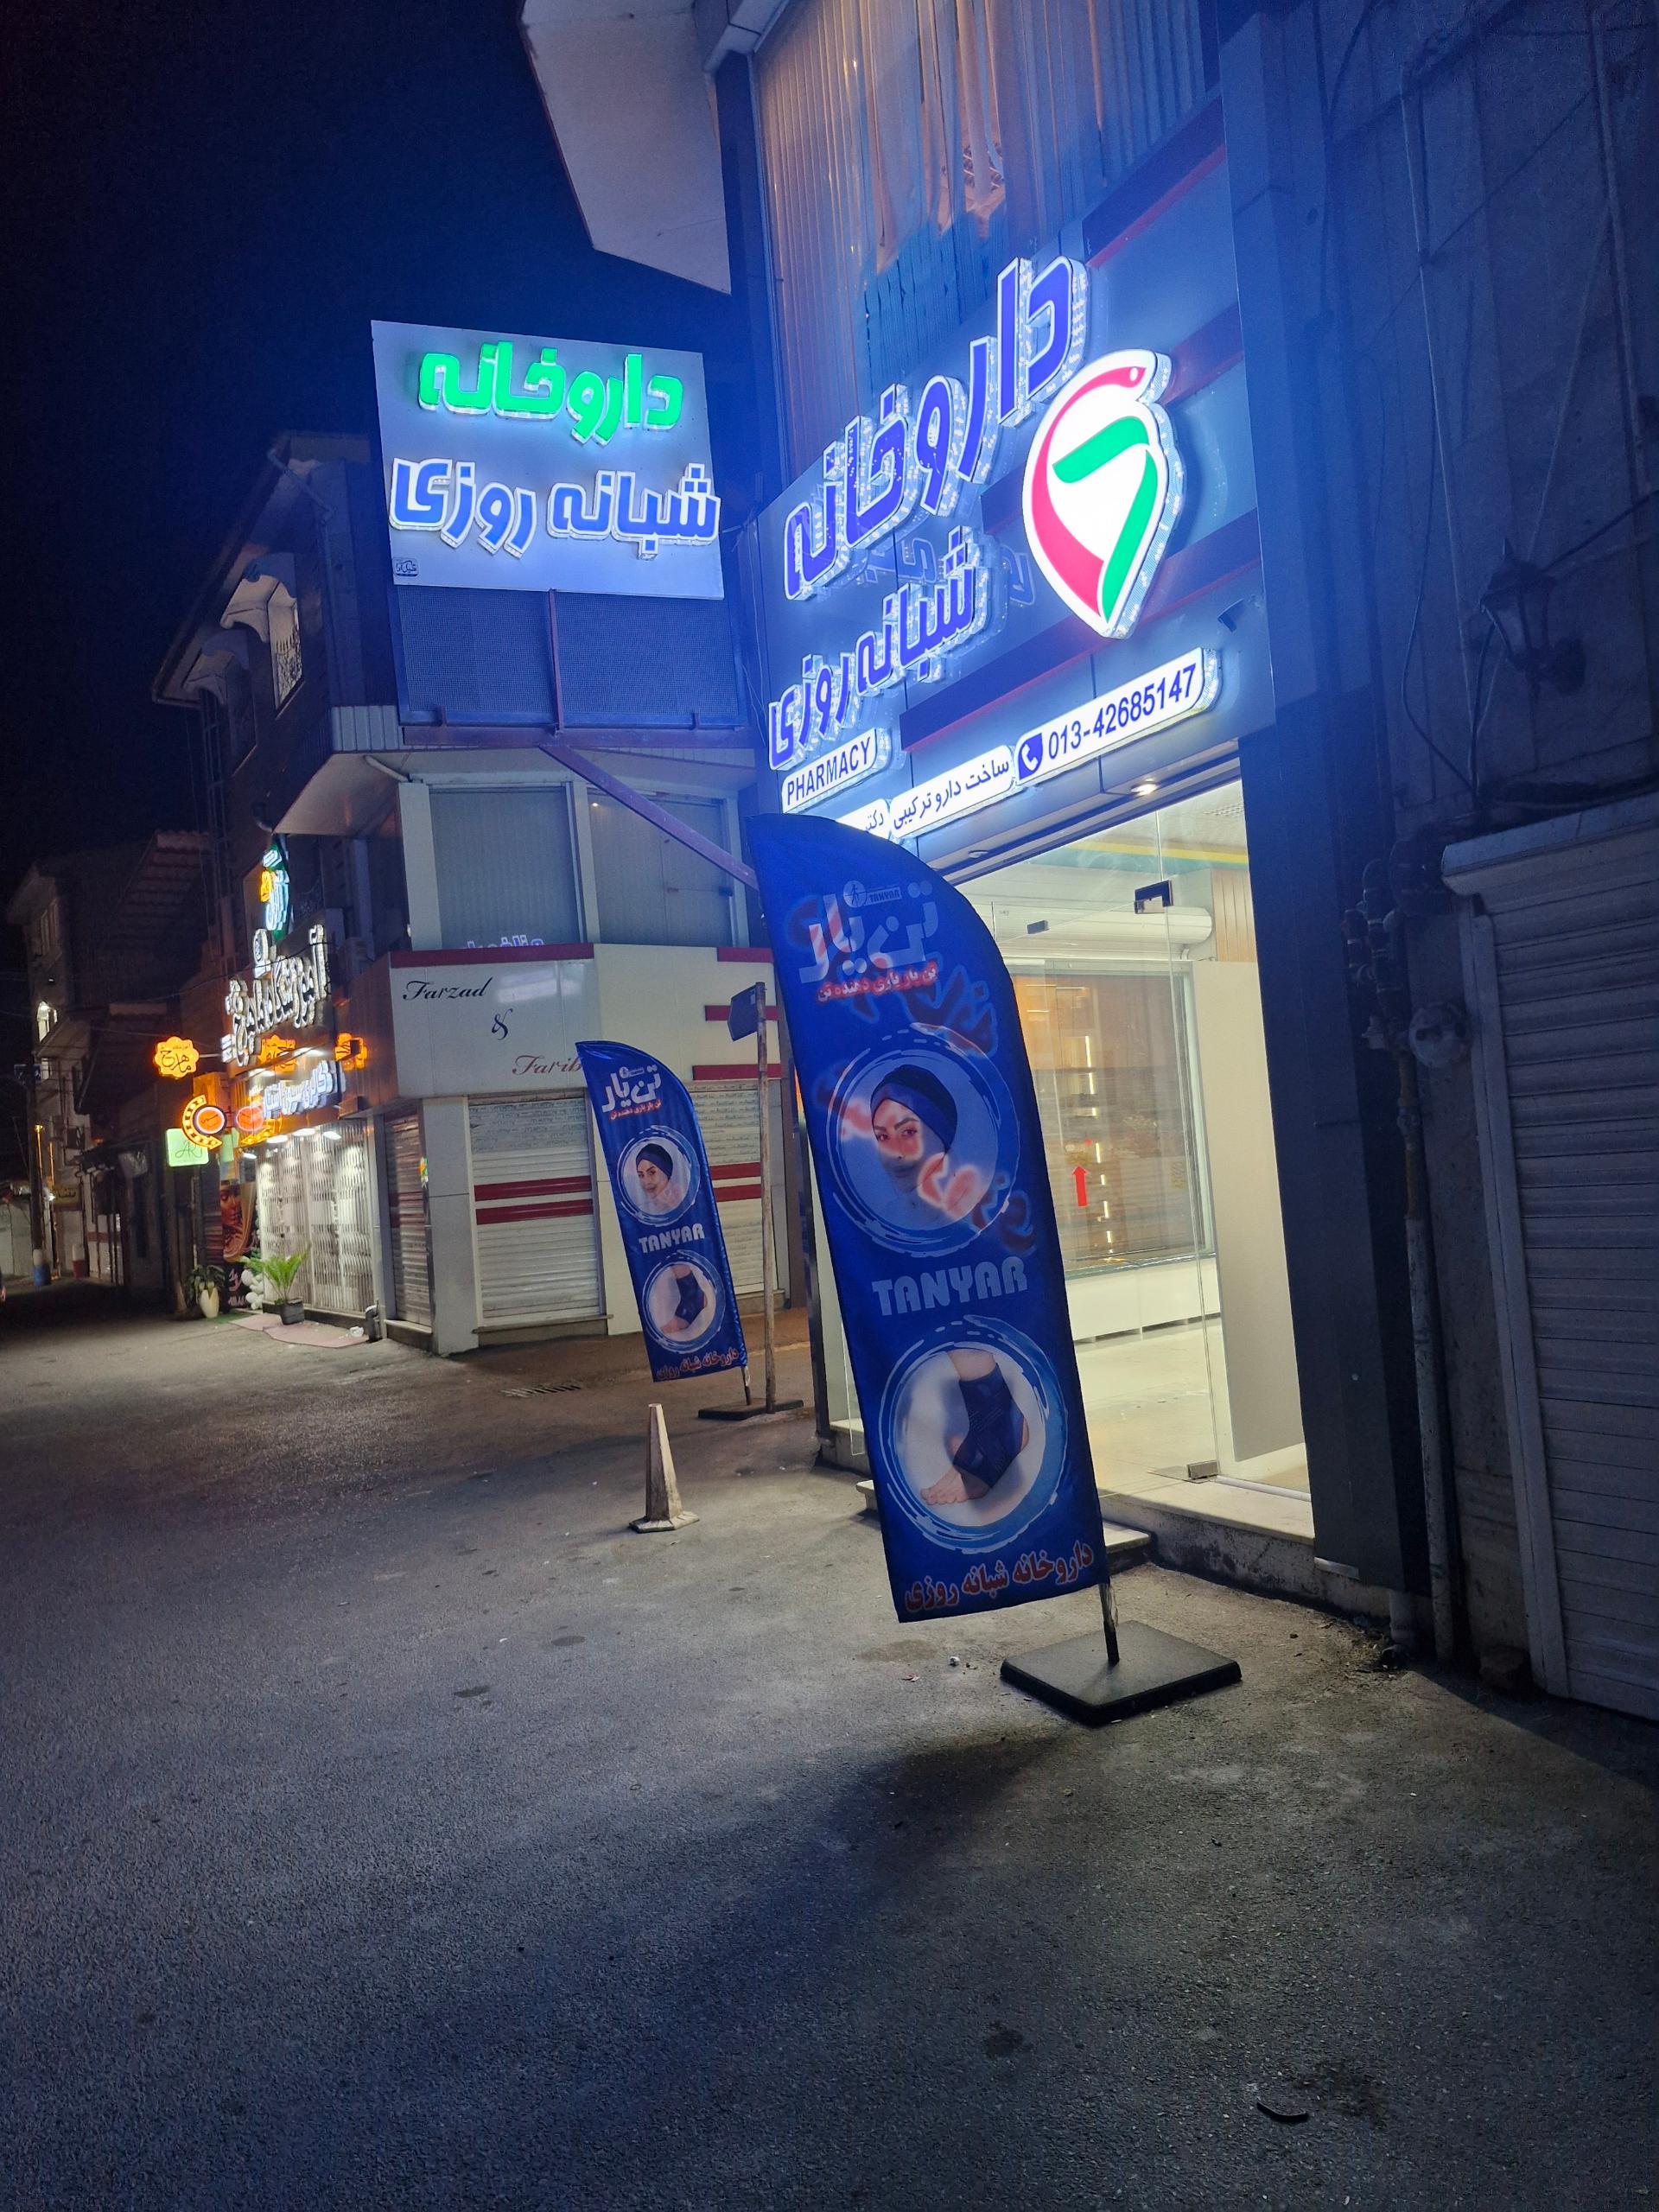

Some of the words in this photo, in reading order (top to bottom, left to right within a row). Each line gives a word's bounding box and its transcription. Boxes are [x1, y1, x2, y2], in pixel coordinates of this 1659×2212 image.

[418, 340, 684, 446] داروخانه
[784, 255, 1084, 600] داروخانه
[389, 457, 537, 559] روزی
[548, 462, 721, 561] شبانه
[855, 524, 983, 696] شبانه
[768, 652, 855, 771] روزی
[1048, 663, 1197, 760] 013-42685147
[786, 736, 872, 806] PHARMACY
[965, 759, 1010, 791] ساخت
[893, 792, 932, 830] ترکیبی
[798, 893, 868, 984] یار
[867, 880, 939, 969] تن
[403, 976, 493, 1001] Farzad
[491, 1008, 513, 1040] &
[601, 1072, 632, 1113] یار
[631, 1065, 662, 1103] تن
[638, 1223, 705, 1254] TANYAR
[871, 1255, 1028, 1317] TANYAR
[702, 1346, 740, 1367] داروخانه
[962, 1559, 1009, 1599] شبانه
[1013, 1539, 1095, 1585] داروخانه
[906, 1574, 959, 1612] روزی
